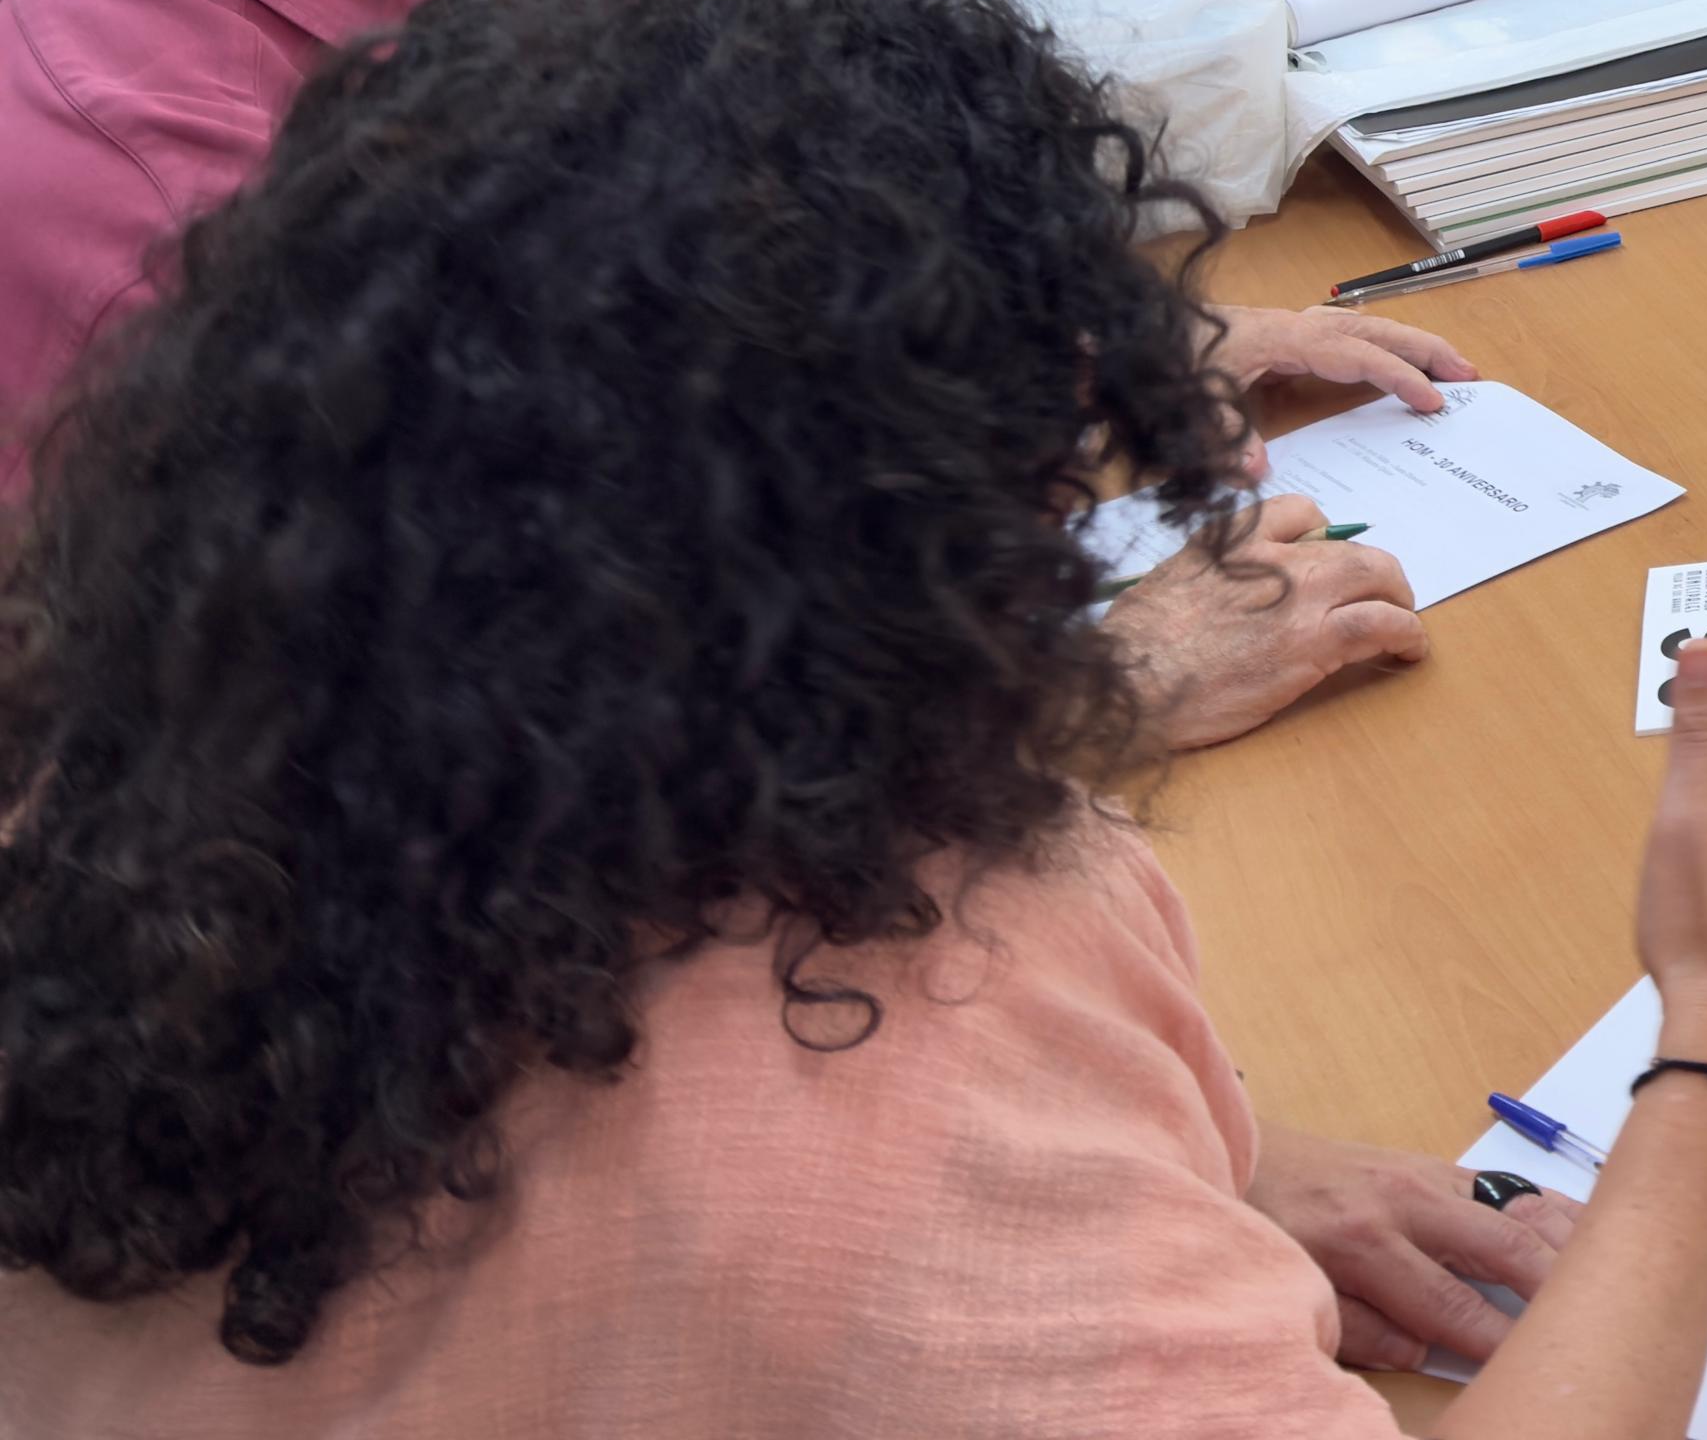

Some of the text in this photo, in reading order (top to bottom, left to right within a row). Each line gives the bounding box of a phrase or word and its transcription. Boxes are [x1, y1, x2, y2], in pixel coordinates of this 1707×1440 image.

[1400, 437, 1435, 457] HOM
[1433, 457, 1454, 470] 30
[1446, 466, 1529, 513] ANIVERSARIO
